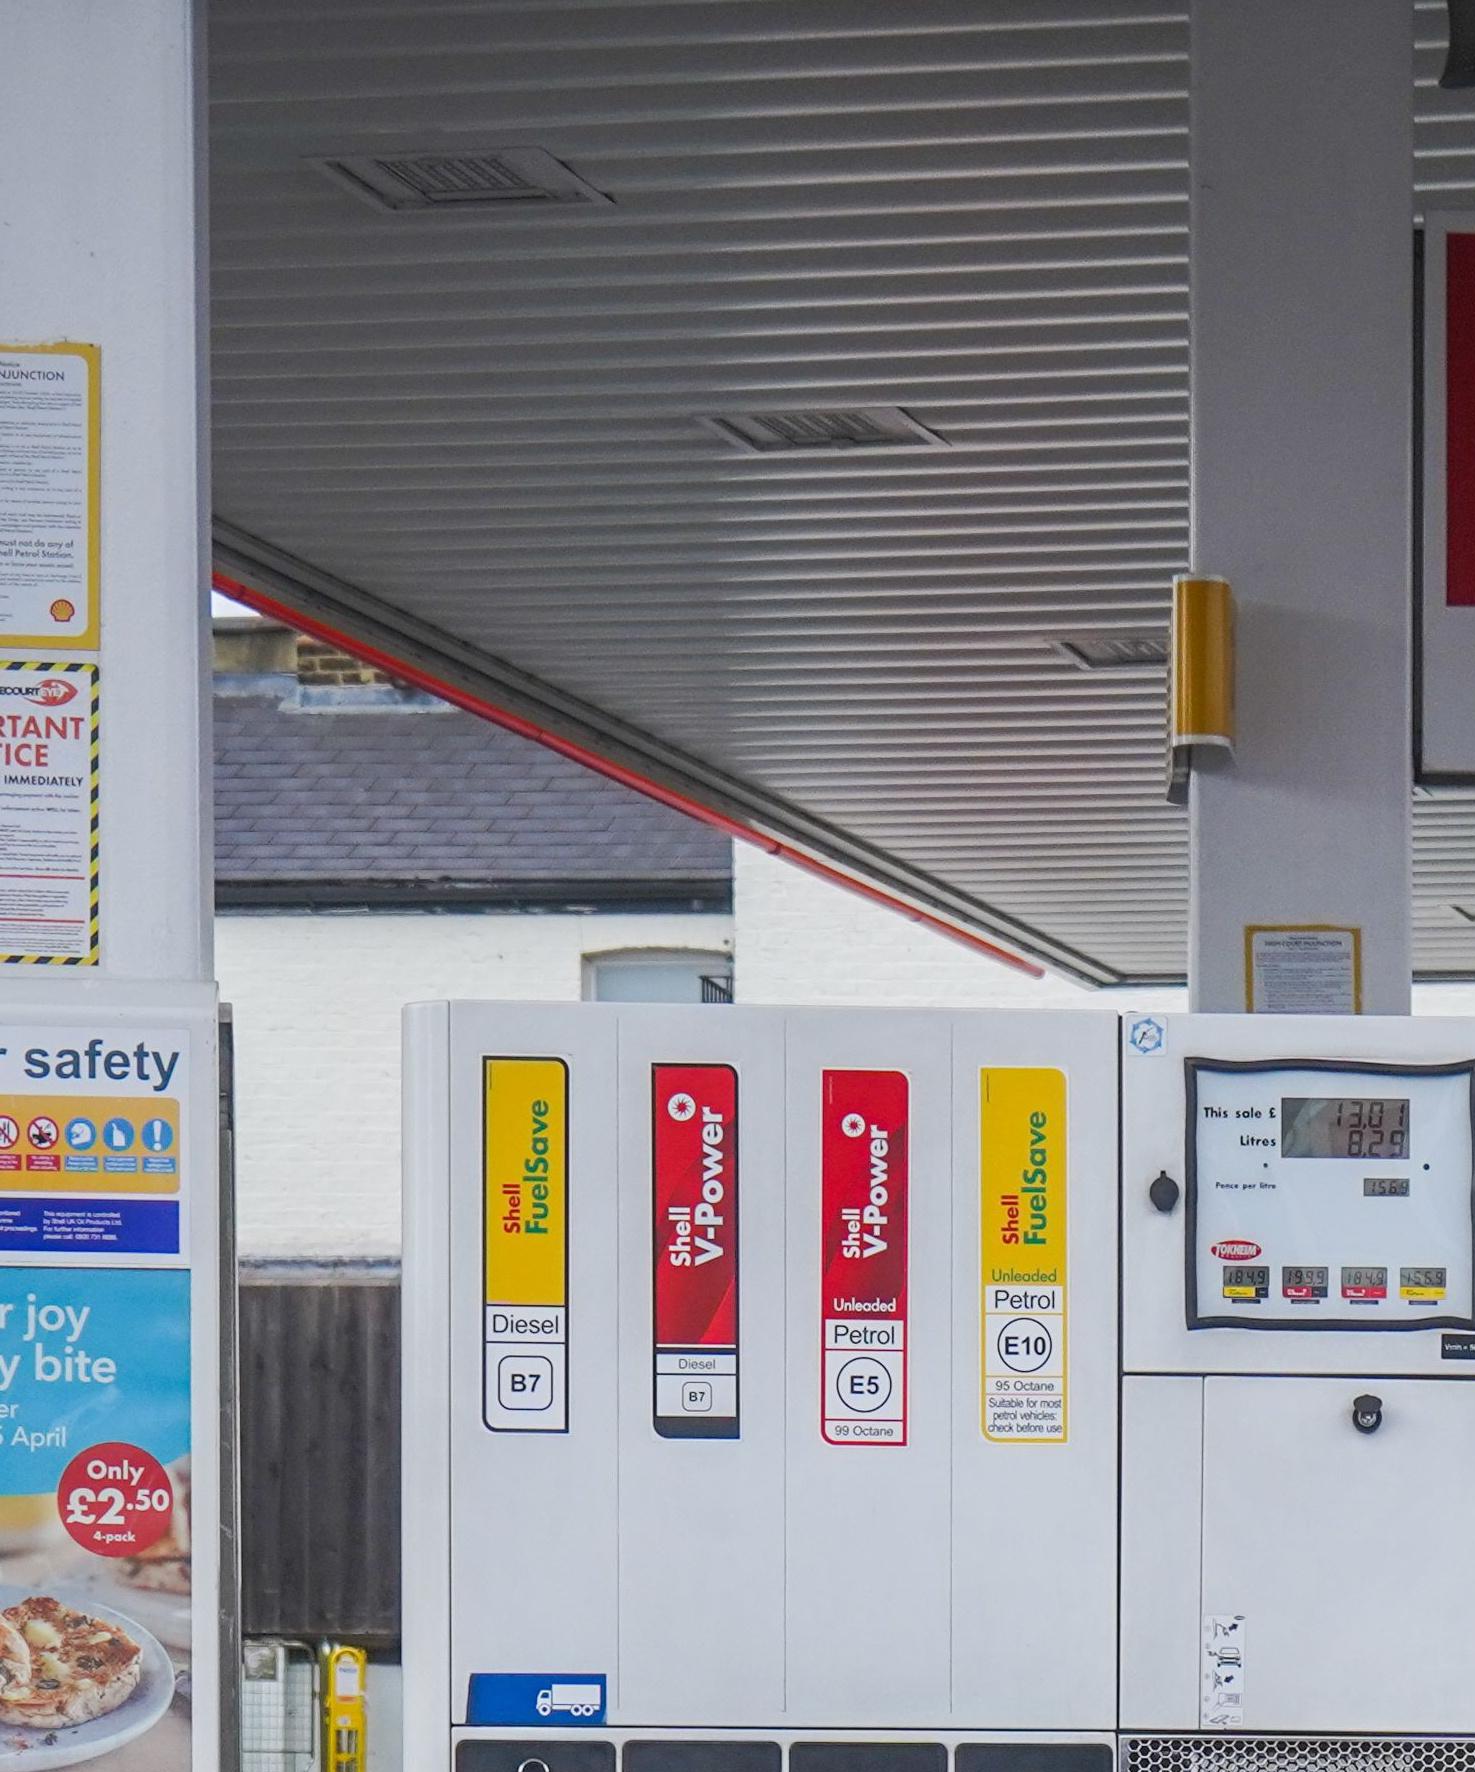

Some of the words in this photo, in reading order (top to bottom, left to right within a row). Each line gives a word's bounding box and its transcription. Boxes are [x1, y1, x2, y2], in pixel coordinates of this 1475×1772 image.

[0, 743, 48, 767] ICE
[4, 775, 84, 787] IMMEDIATELY
[24, 1039, 180, 1092] safety
[1204, 1107, 1228, 1119] This
[1235, 1107, 1262, 1119] sale
[1269, 1107, 1276, 1119] £
[1240, 1135, 1277, 1148] Litres
[502, 1183, 521, 1234] Shell
[523, 1099, 549, 1235] FuelSave
[668, 1206, 691, 1267] Shell
[694, 1106, 723, 1267] V-Power
[1002, 1195, 1019, 1245] Shell
[1021, 1111, 1047, 1245] FuelSave
[1242, 1183, 1256, 1192] per
[841, 1208, 861, 1259] Shell
[863, 1124, 889, 1258] V-Power
[991, 1269, 1058, 1284] Unleaded
[833, 1298, 897, 1313] Unleaded
[994, 1290, 1055, 1311] Petrol
[23, 1293, 91, 1342] joy
[492, 1314, 560, 1336] Diesel
[833, 1325, 896, 1345] Petrol
[1004, 1336, 1047, 1356] E10
[35, 1342, 117, 1384] bite
[678, 1358, 716, 1371] Diesel
[511, 1374, 541, 1393] B7
[850, 1376, 879, 1395] E5
[995, 1380, 1010, 1391] 95
[1013, 1380, 1055, 1392] Octane
[688, 1391, 706, 1403] B7
[1026, 1397, 1038, 1408] for
[1040, 1399, 1062, 1409] most
[11, 1426, 66, 1451] April
[834, 1425, 850, 1437] 99
[852, 1425, 894, 1438] Octane
[87, 1459, 145, 1487] Only
[66, 1487, 170, 1525] £2.50
[93, 1531, 136, 1544] 4-pack
